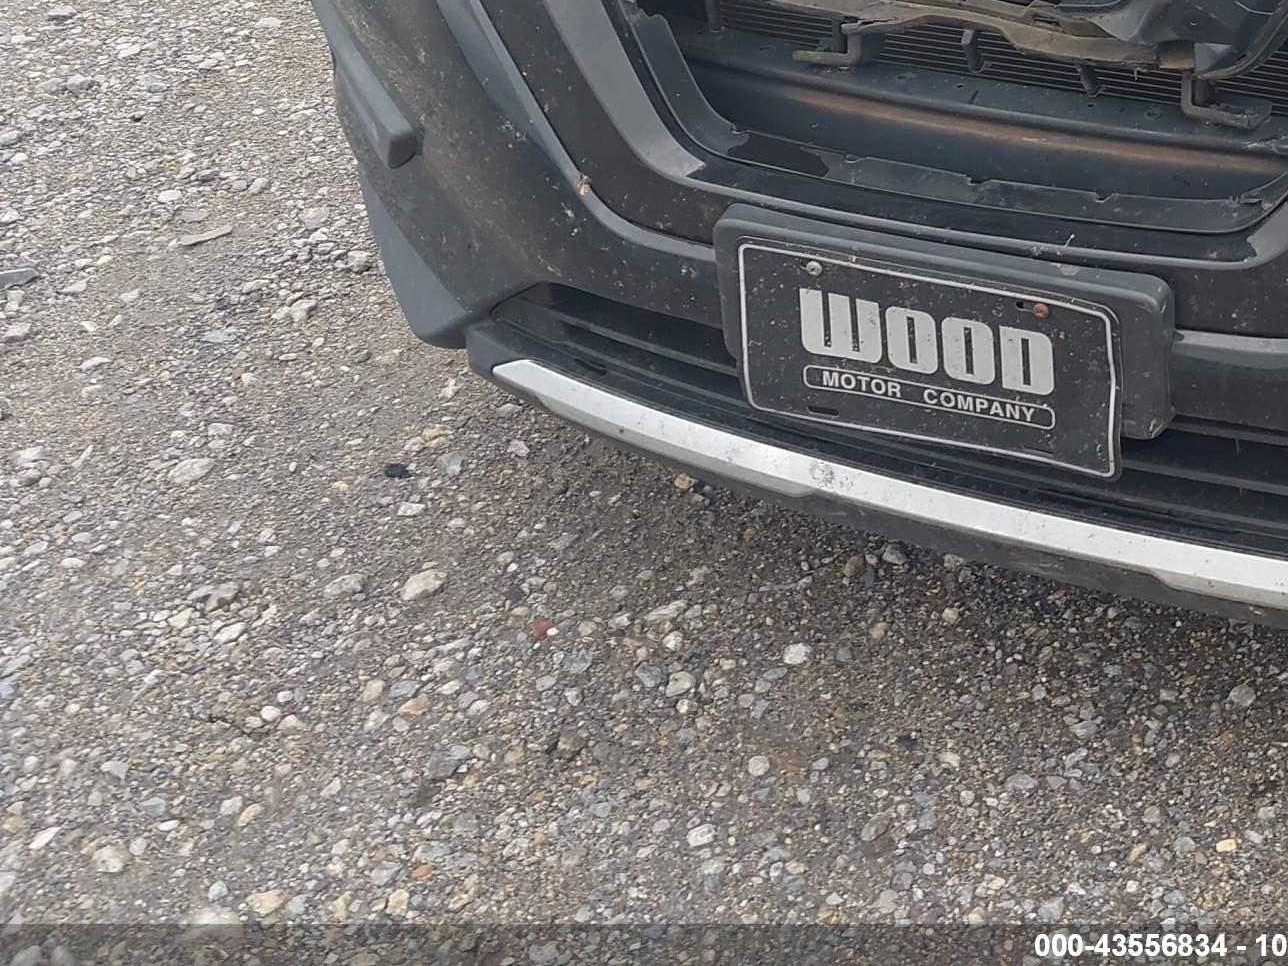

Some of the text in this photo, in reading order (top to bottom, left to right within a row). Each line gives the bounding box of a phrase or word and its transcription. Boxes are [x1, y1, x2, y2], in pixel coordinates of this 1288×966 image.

[799, 287, 1055, 395] WOOD
[822, 370, 1035, 422] MOTOR COMPANY
